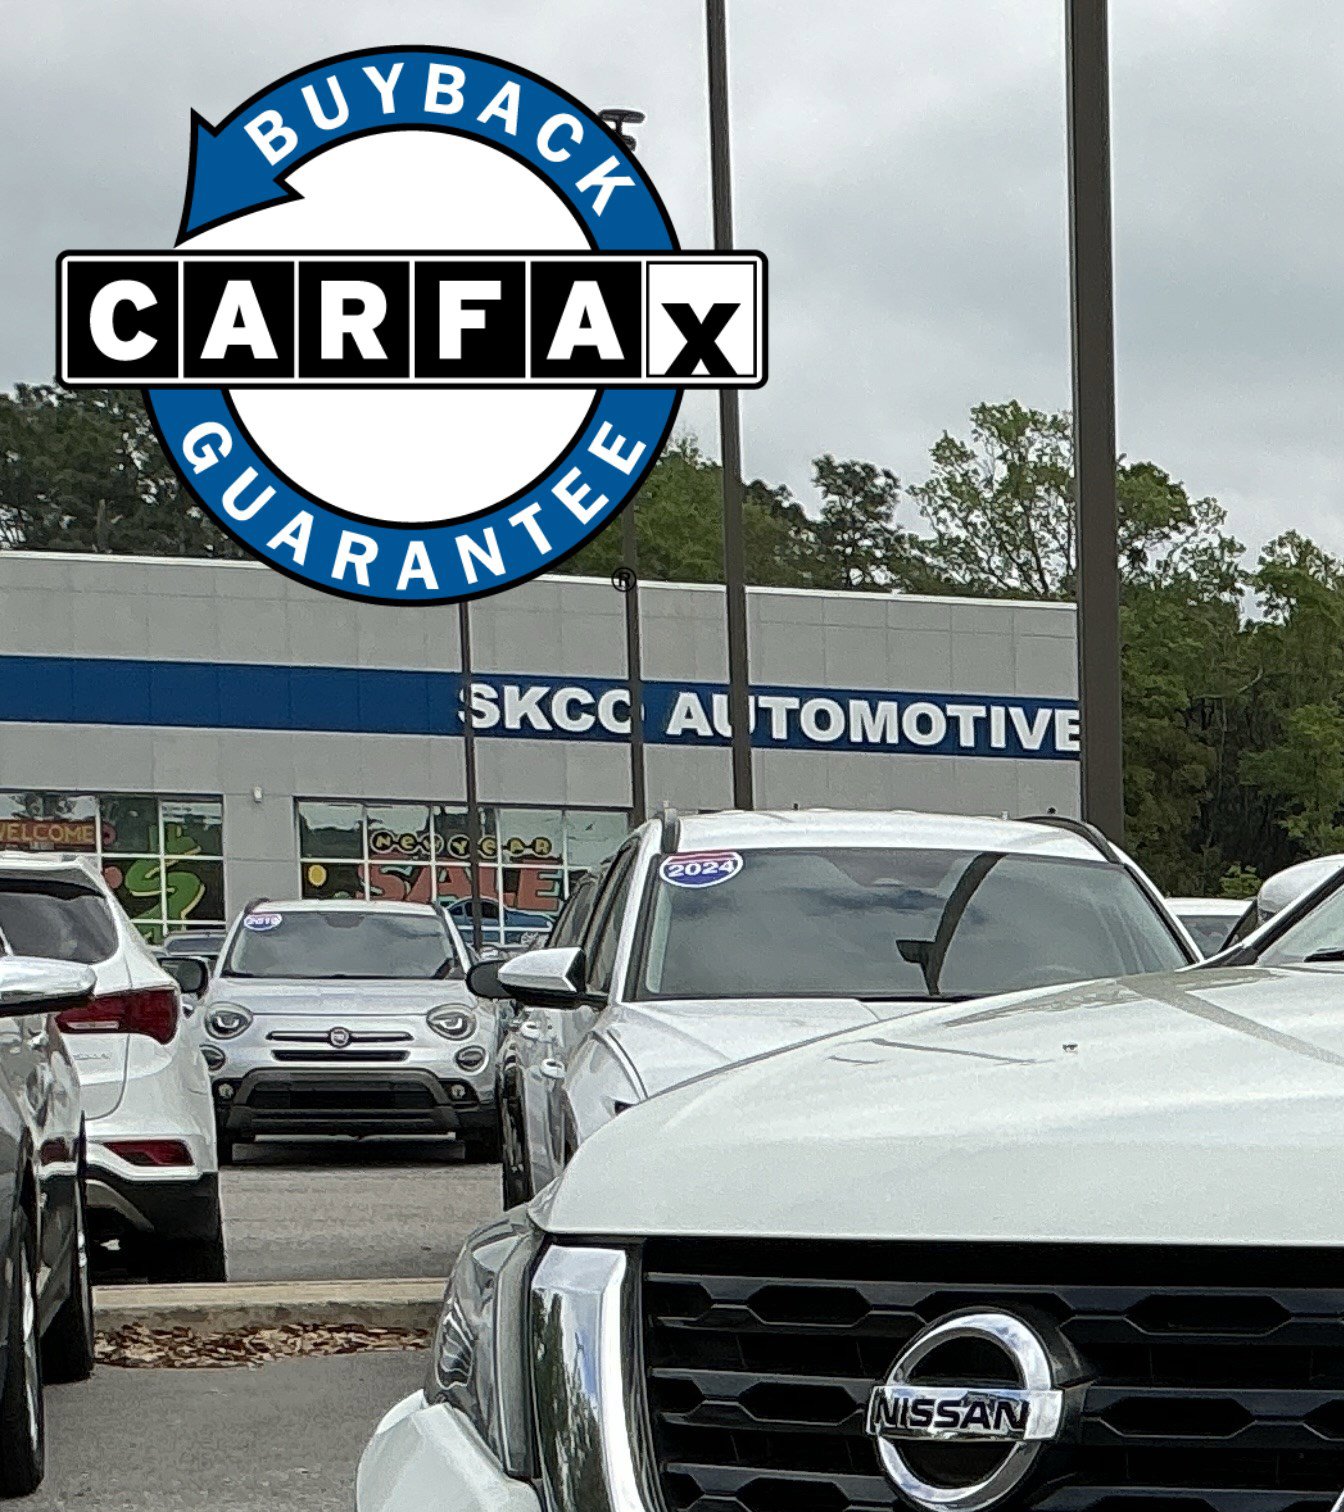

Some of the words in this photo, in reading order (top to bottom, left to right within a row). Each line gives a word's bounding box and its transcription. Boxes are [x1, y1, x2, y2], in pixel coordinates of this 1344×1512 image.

[458, 683, 645, 734] SKCO
[666, 691, 1081, 751] AUTOMOTIVE
[356, 852, 561, 911] SALE
[668, 860, 735, 878] 2024
[873, 1397, 1030, 1431] NISSAN
